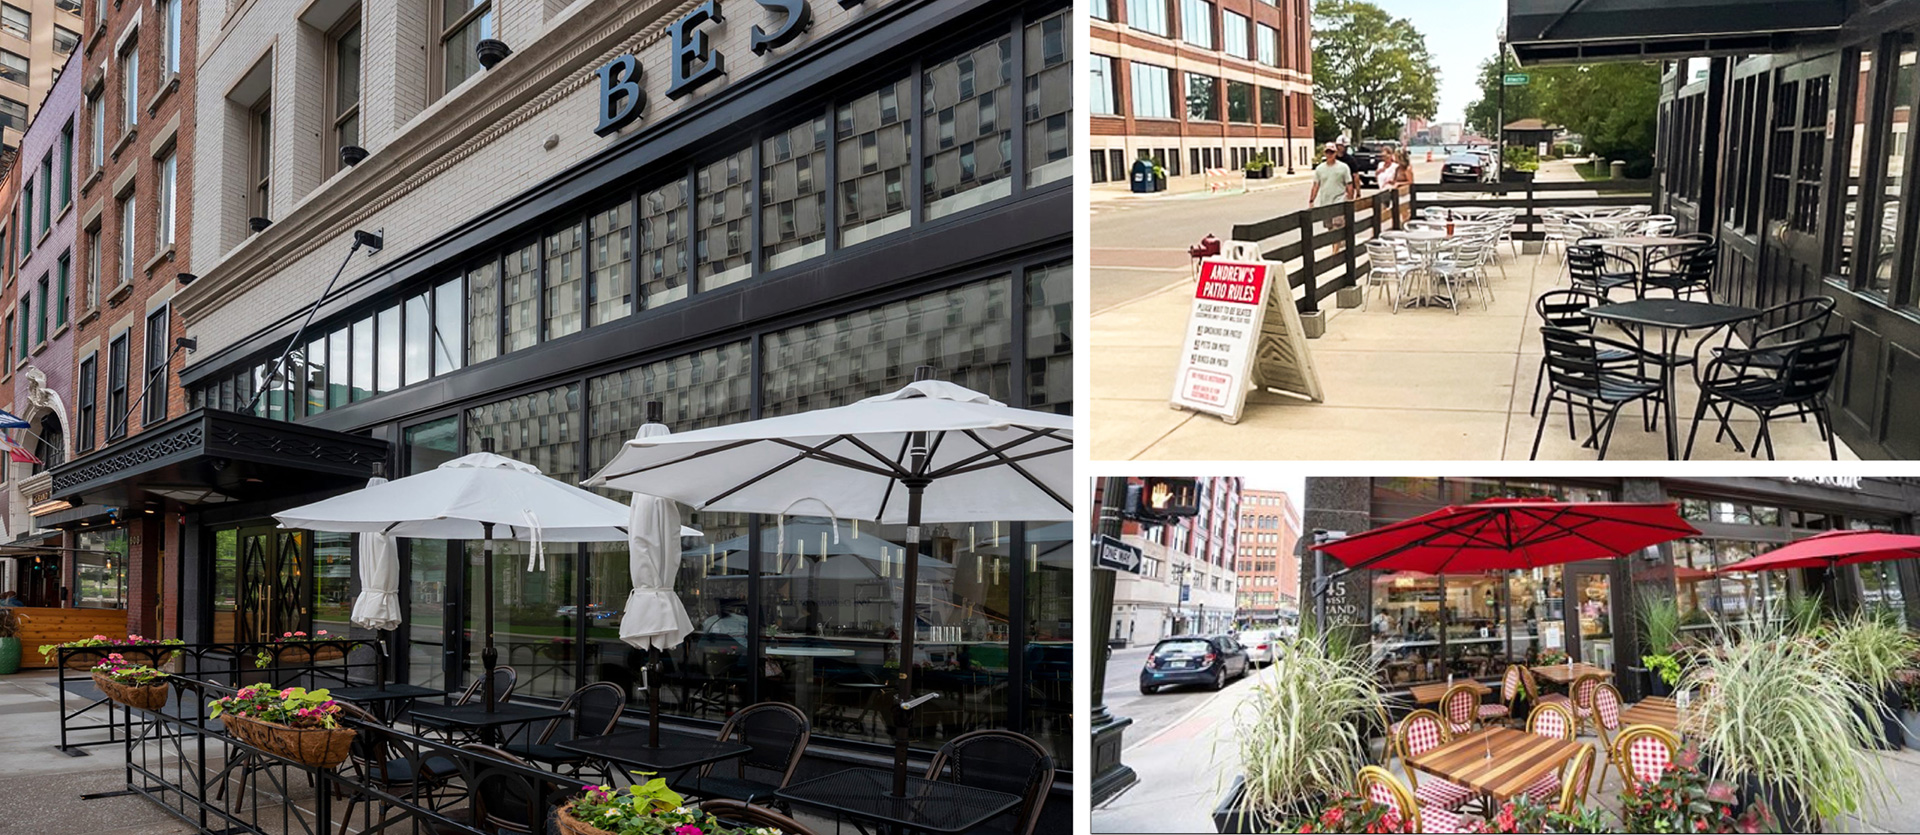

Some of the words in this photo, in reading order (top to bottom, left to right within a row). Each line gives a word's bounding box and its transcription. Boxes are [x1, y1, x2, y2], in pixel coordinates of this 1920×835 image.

[593, 0, 866, 137] BES
[1209, 264, 1256, 283] ANDREW'S
[1202, 281, 1227, 299] PATIO
[1227, 284, 1256, 302] RULES
[1103, 544, 1119, 561] ONE
[1118, 550, 1131, 565] WAY
